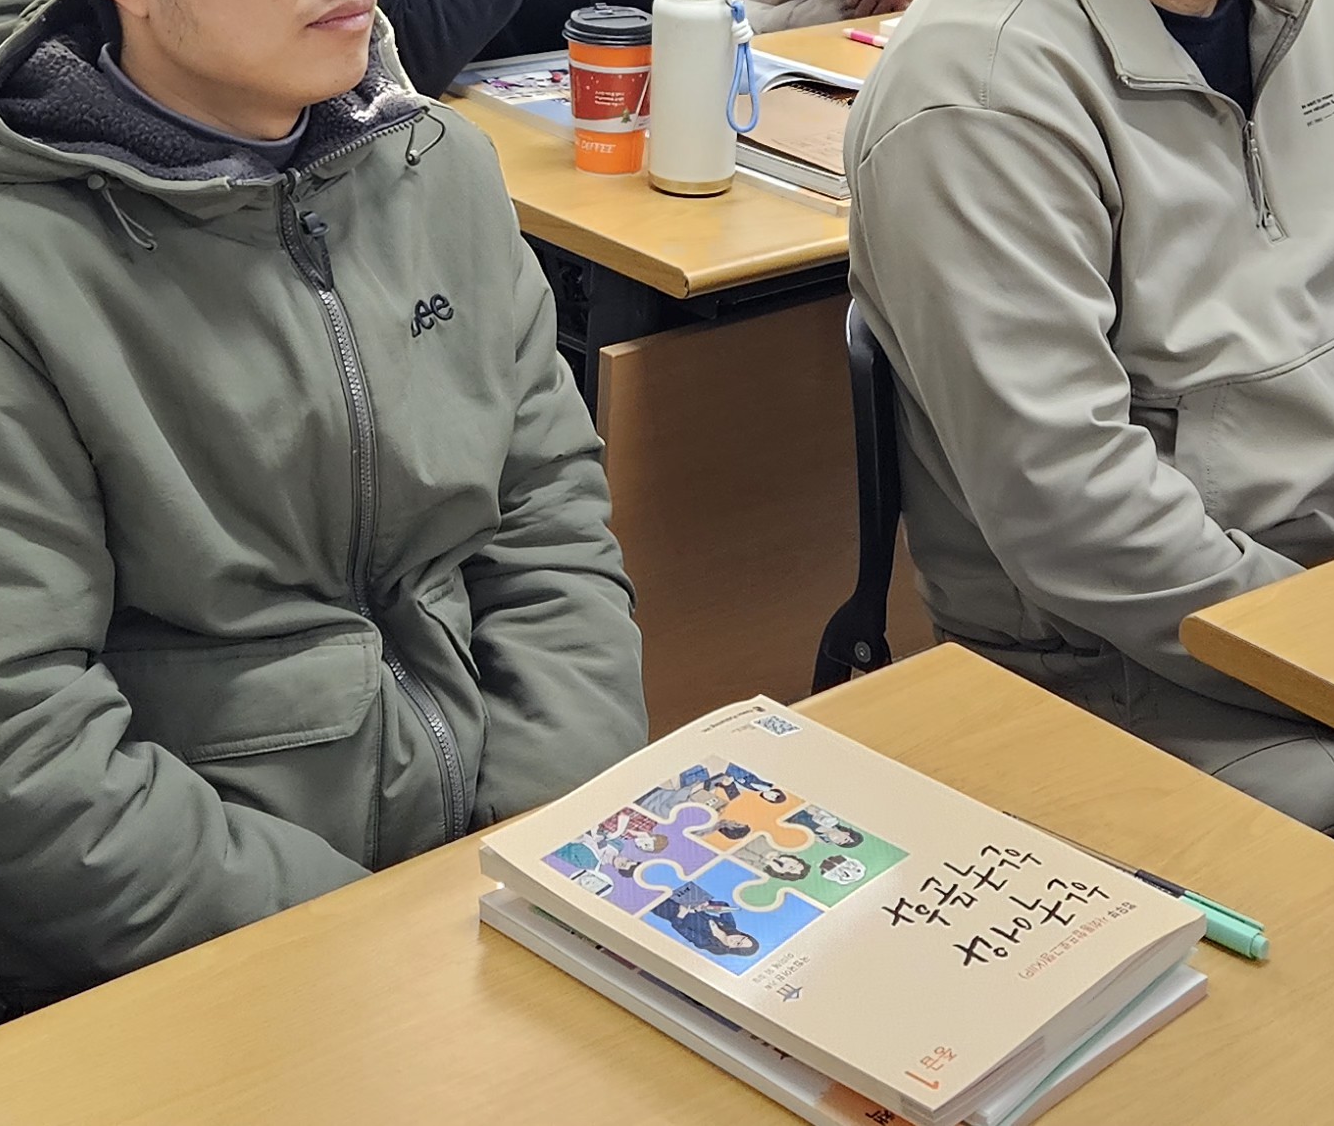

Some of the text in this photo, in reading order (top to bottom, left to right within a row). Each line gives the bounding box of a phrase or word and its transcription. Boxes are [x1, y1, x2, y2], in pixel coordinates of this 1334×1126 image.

[881, 844, 1043, 927] 한국문화
[952, 877, 1111, 967] 한국어와
[904, 1070, 940, 1090] 1
[920, 1046, 957, 1071] 중급
